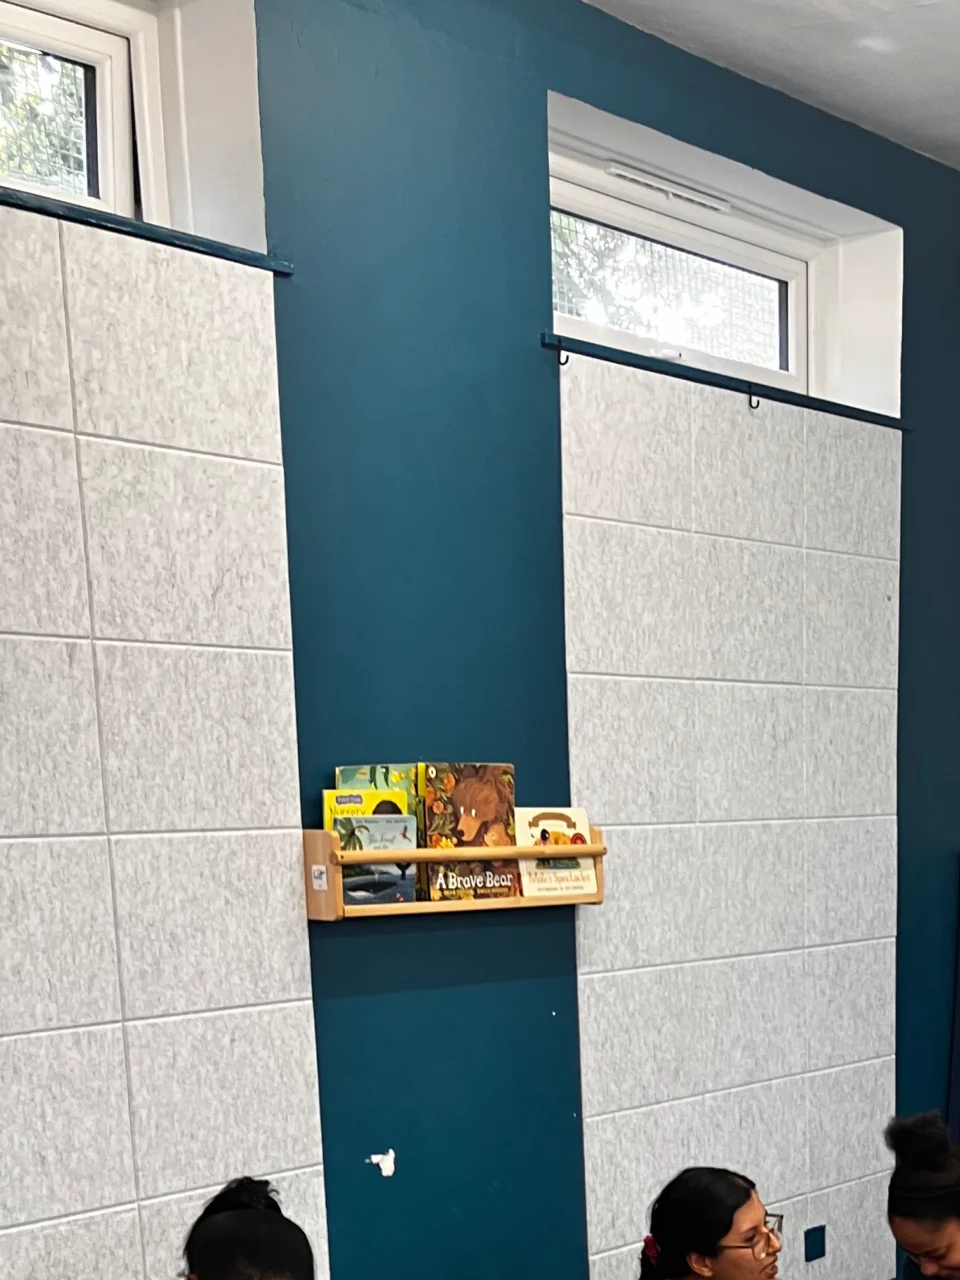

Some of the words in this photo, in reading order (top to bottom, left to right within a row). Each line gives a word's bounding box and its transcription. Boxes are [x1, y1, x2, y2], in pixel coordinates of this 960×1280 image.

[436, 872, 446, 889] A
[448, 871, 484, 889] Brave
[485, 870, 513, 887] Bear
